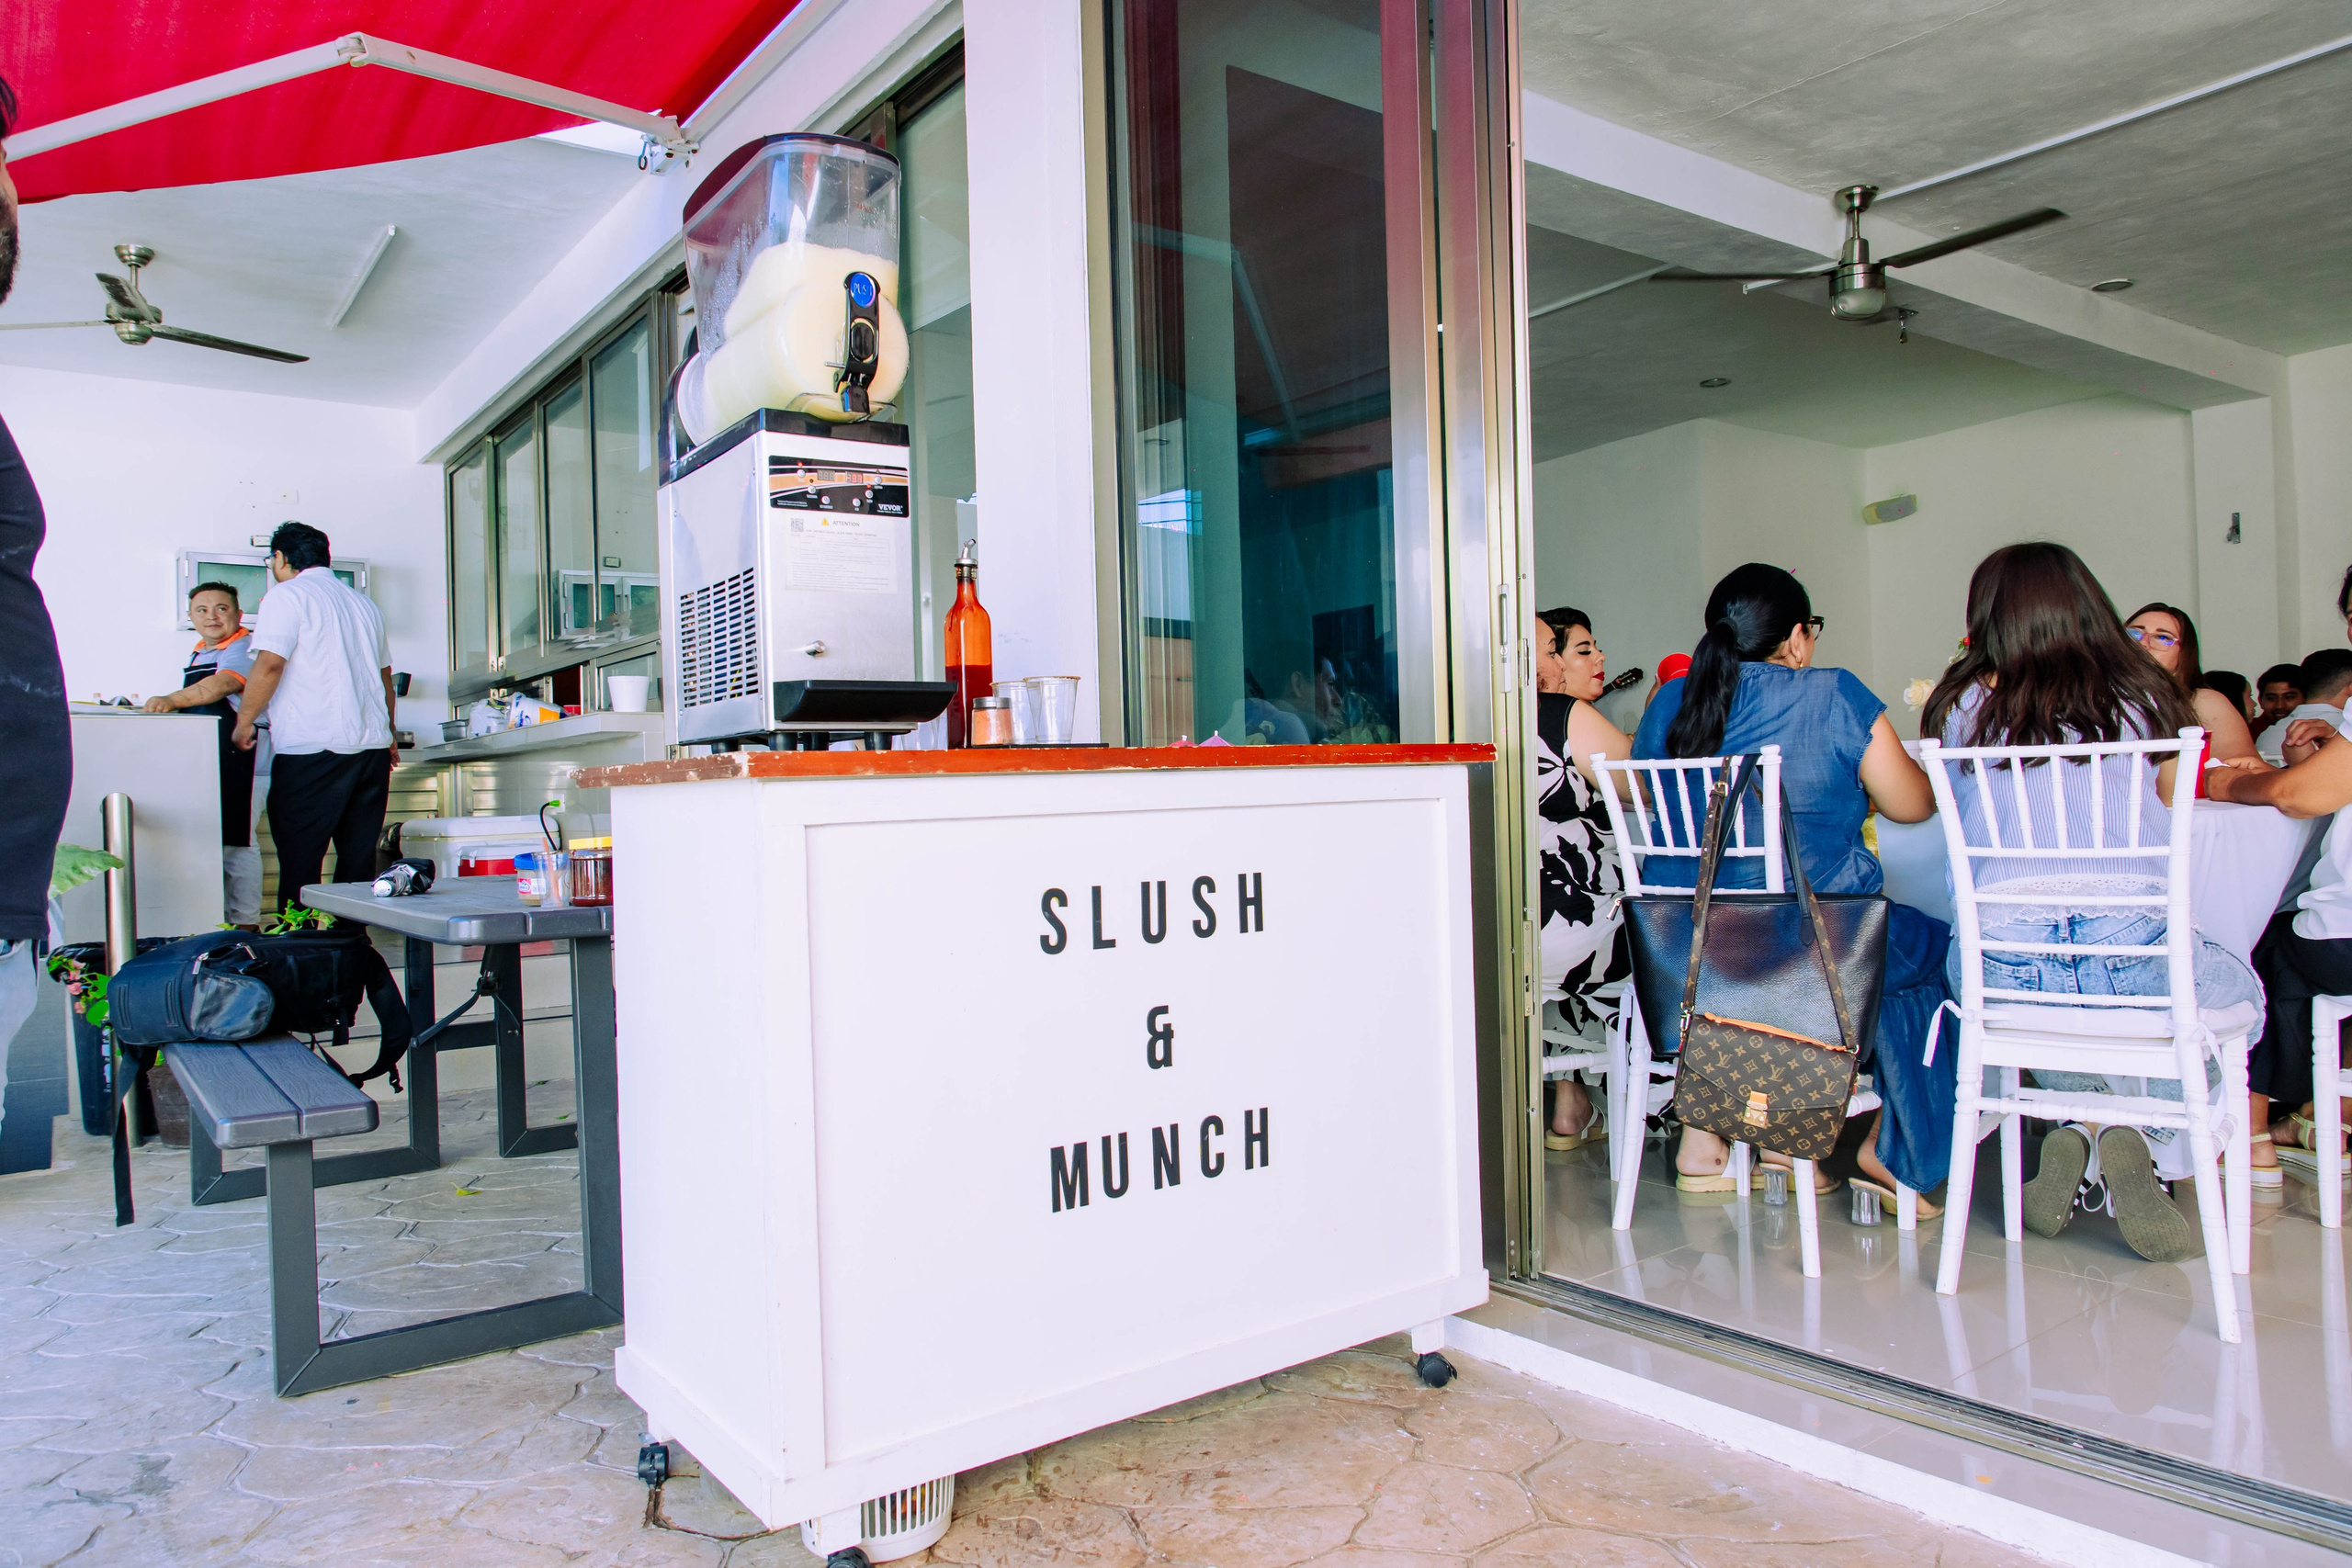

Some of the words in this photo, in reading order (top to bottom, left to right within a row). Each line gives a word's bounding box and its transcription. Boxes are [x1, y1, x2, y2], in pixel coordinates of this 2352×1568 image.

[877, 503, 901, 512] VEVOR
[1039, 872, 1264, 955] SLUSH
[1147, 1005, 1174, 1070] &
[1050, 1107, 1269, 1213] MUNCH
